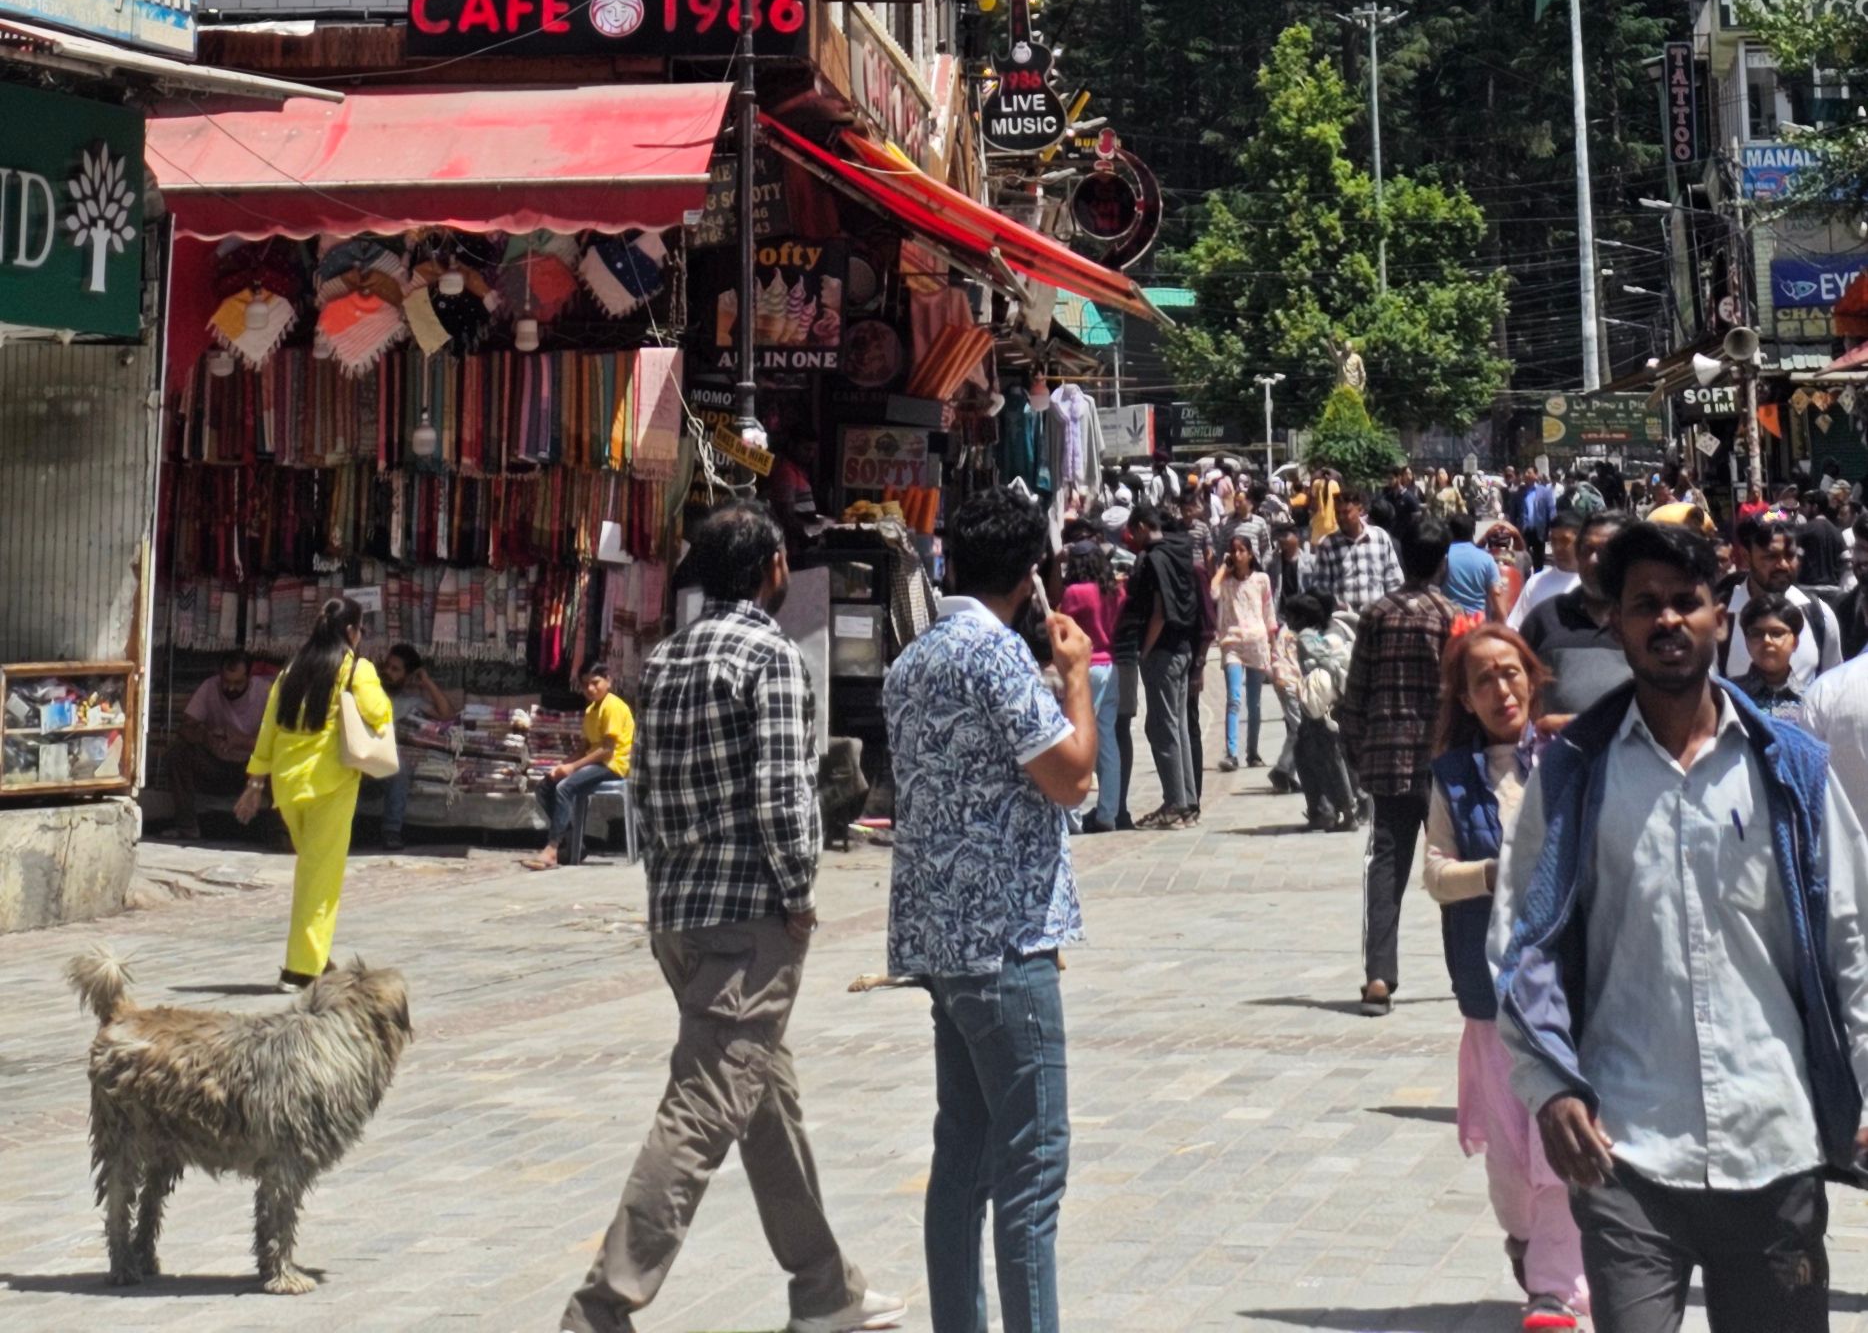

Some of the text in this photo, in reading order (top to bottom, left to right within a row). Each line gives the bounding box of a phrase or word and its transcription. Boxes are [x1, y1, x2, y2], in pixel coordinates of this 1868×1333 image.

[1000, 94, 1046, 112] LIVE
[1669, 47, 1691, 160] TATTOO
[991, 116, 1057, 135] MUSIC
[1746, 148, 1822, 168] MANAL
[0, 167, 55, 268] D
[752, 241, 823, 271] ofty
[763, 350, 787, 368] IN
[791, 350, 838, 368] ONE
[1683, 386, 1739, 405] SOFT
[1180, 425, 1225, 438] NIGHTCLUB
[844, 457, 926, 487] SOFTY
